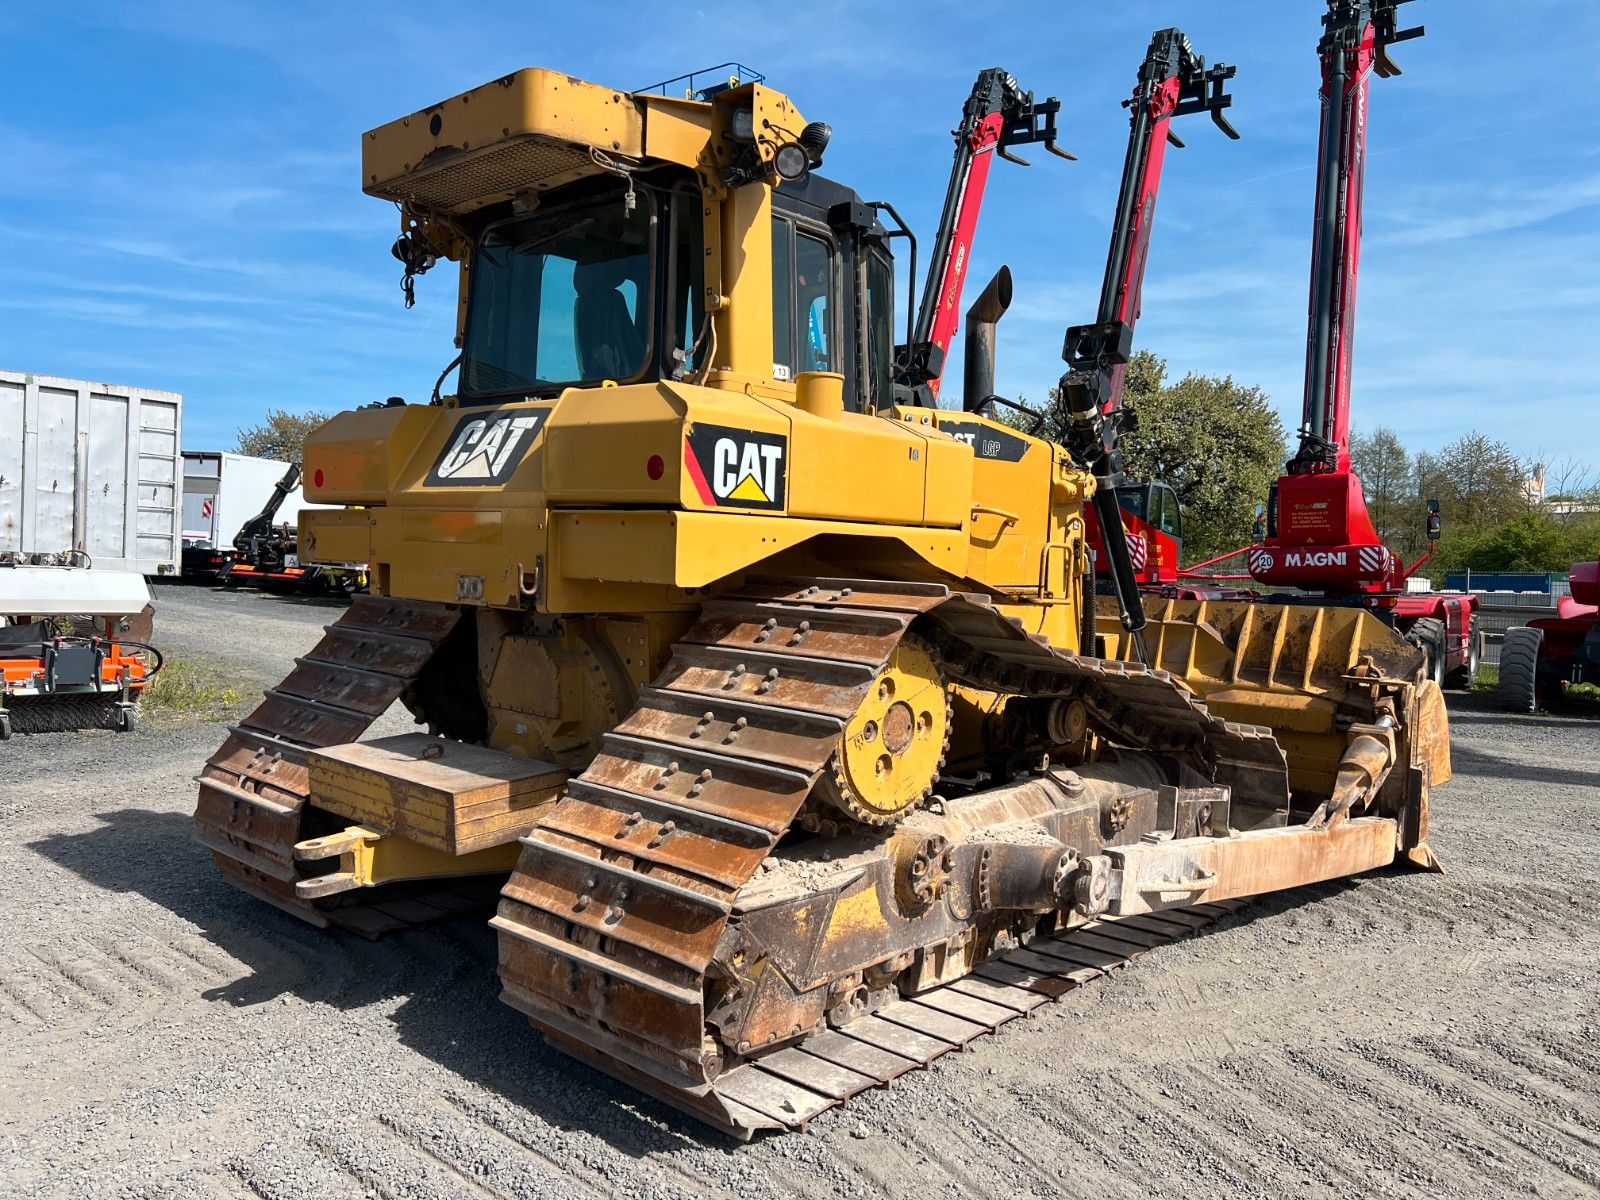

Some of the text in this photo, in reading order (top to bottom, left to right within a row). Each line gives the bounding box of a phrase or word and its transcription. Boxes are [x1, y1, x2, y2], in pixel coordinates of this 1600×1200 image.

[438, 416, 538, 478] CAT
[982, 440, 1001, 457] LGP
[713, 437, 782, 502] CAT
[1260, 556, 1272, 567] 20
[1284, 551, 1347, 567] MAGNI
